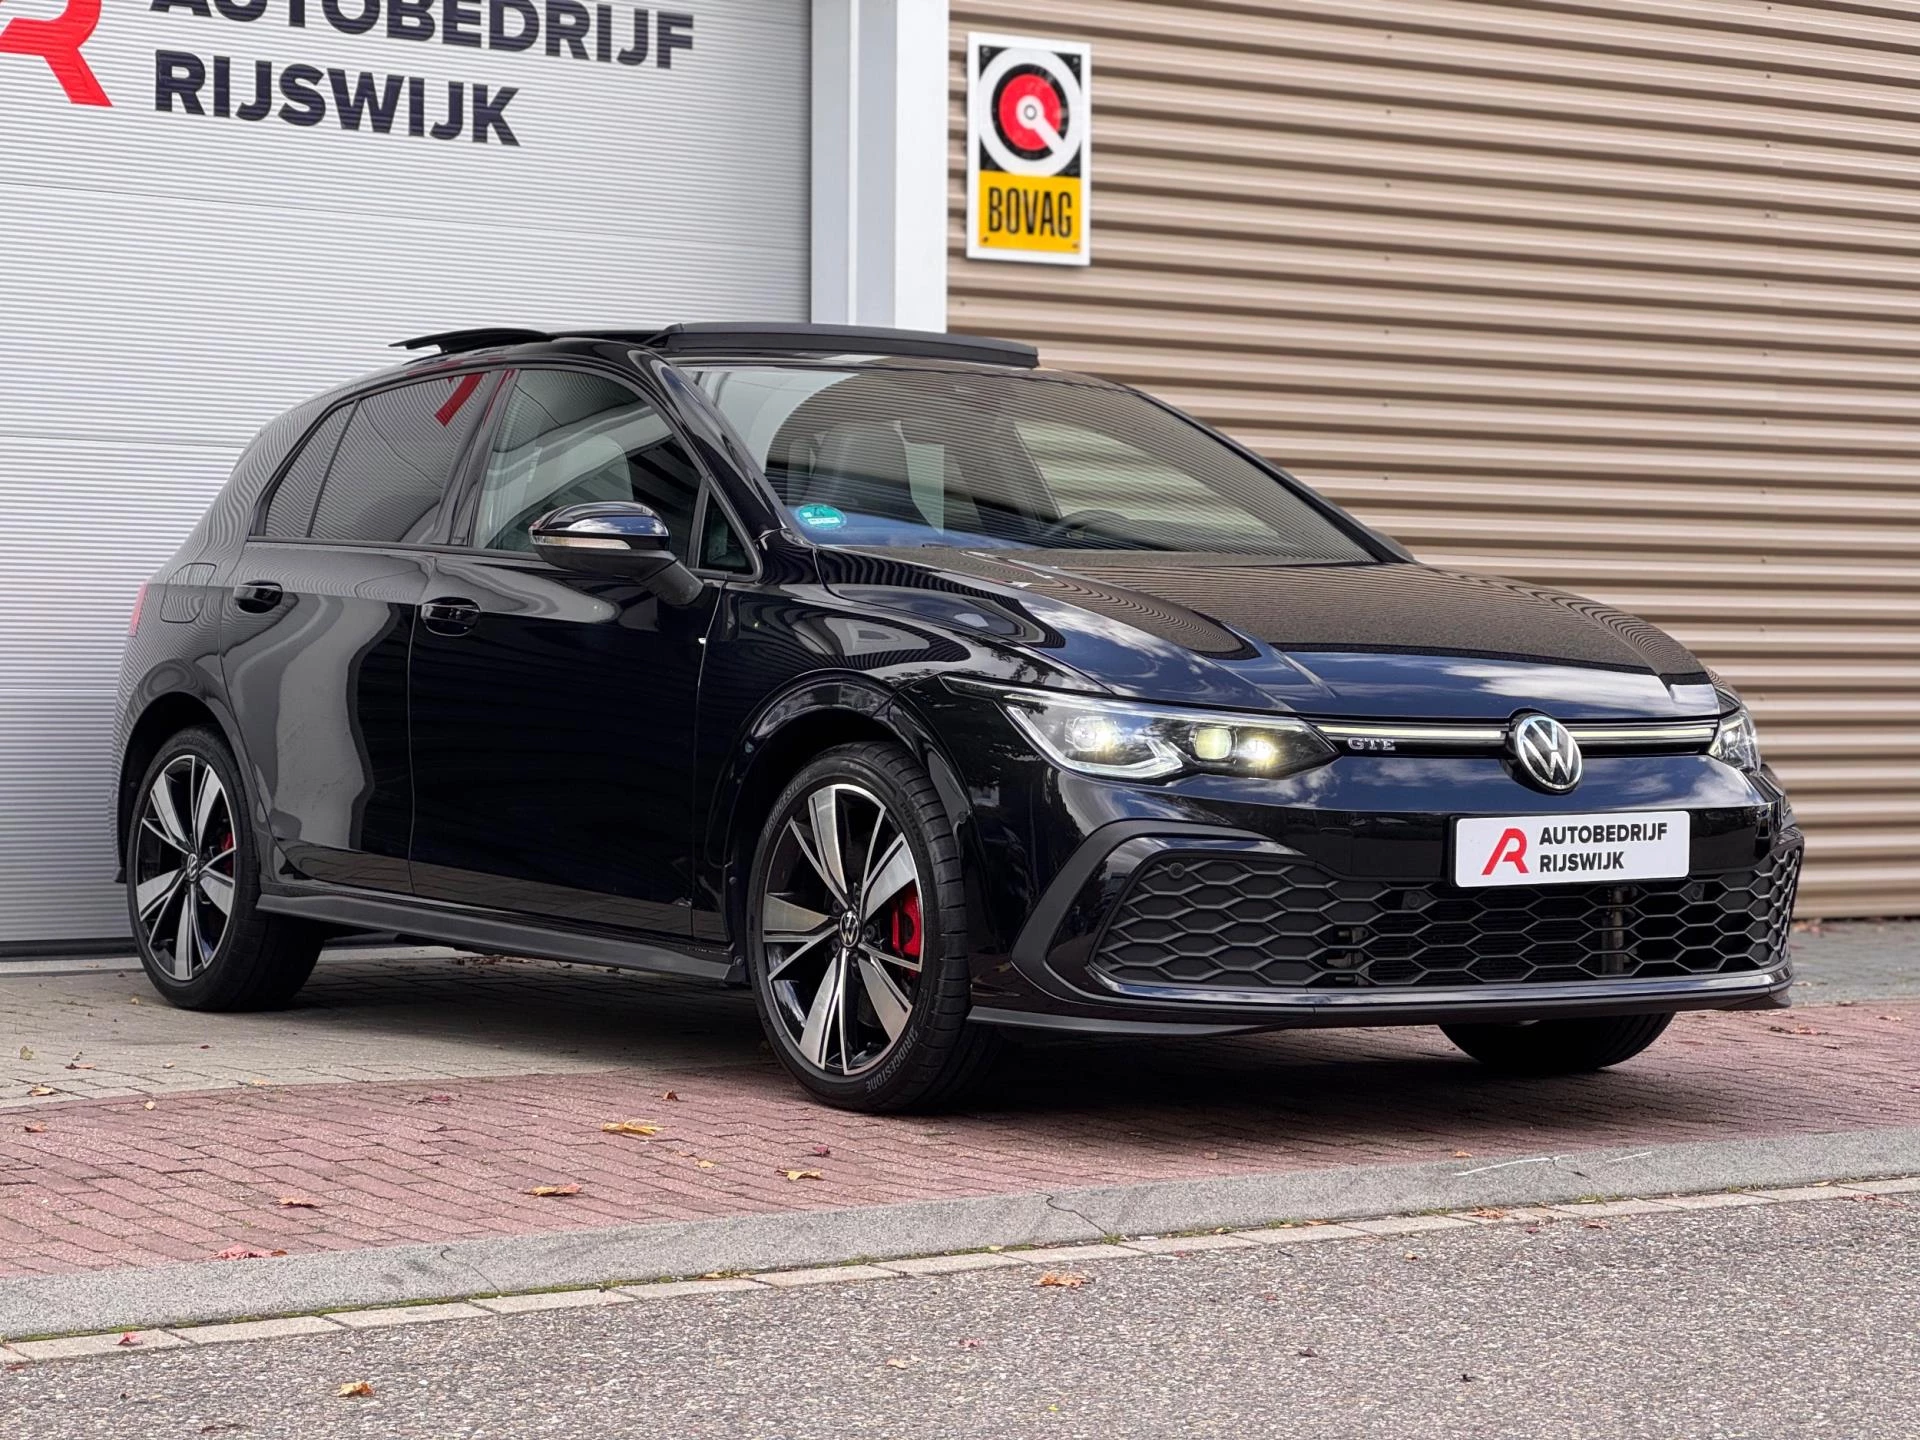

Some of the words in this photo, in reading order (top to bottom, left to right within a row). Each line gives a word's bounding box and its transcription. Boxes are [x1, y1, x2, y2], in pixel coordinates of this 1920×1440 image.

[155, 49, 520, 147] RIJSWIJK
[987, 186, 1073, 238] BOVAG
[1347, 737, 1396, 751] GTE
[1539, 822, 1668, 845] AUTOBEDRIJF
[1539, 851, 1625, 873] RIJSWIJK
[865, 1025, 919, 1093] BRIDGESTONE
